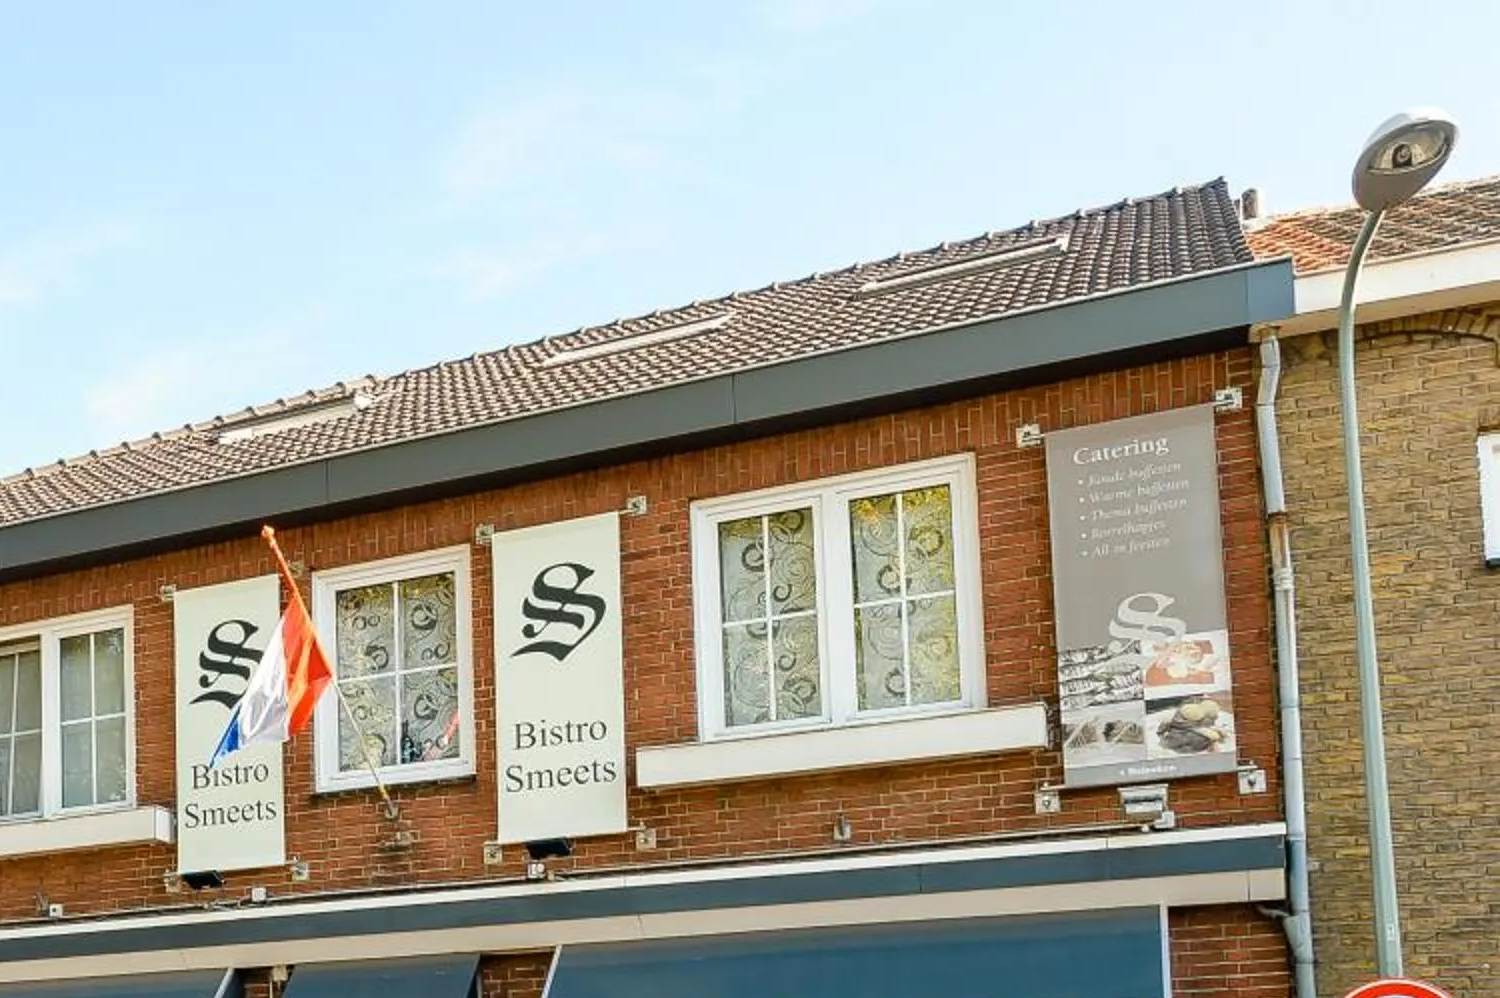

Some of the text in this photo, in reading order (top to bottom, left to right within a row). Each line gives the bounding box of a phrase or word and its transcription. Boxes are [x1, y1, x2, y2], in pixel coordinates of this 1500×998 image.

[1073, 438, 1170, 465] Catering
[514, 720, 607, 750] Bistro
[191, 760, 269, 790] Bistro
[505, 758, 617, 793] Smeets
[185, 799, 277, 829] Smeets
